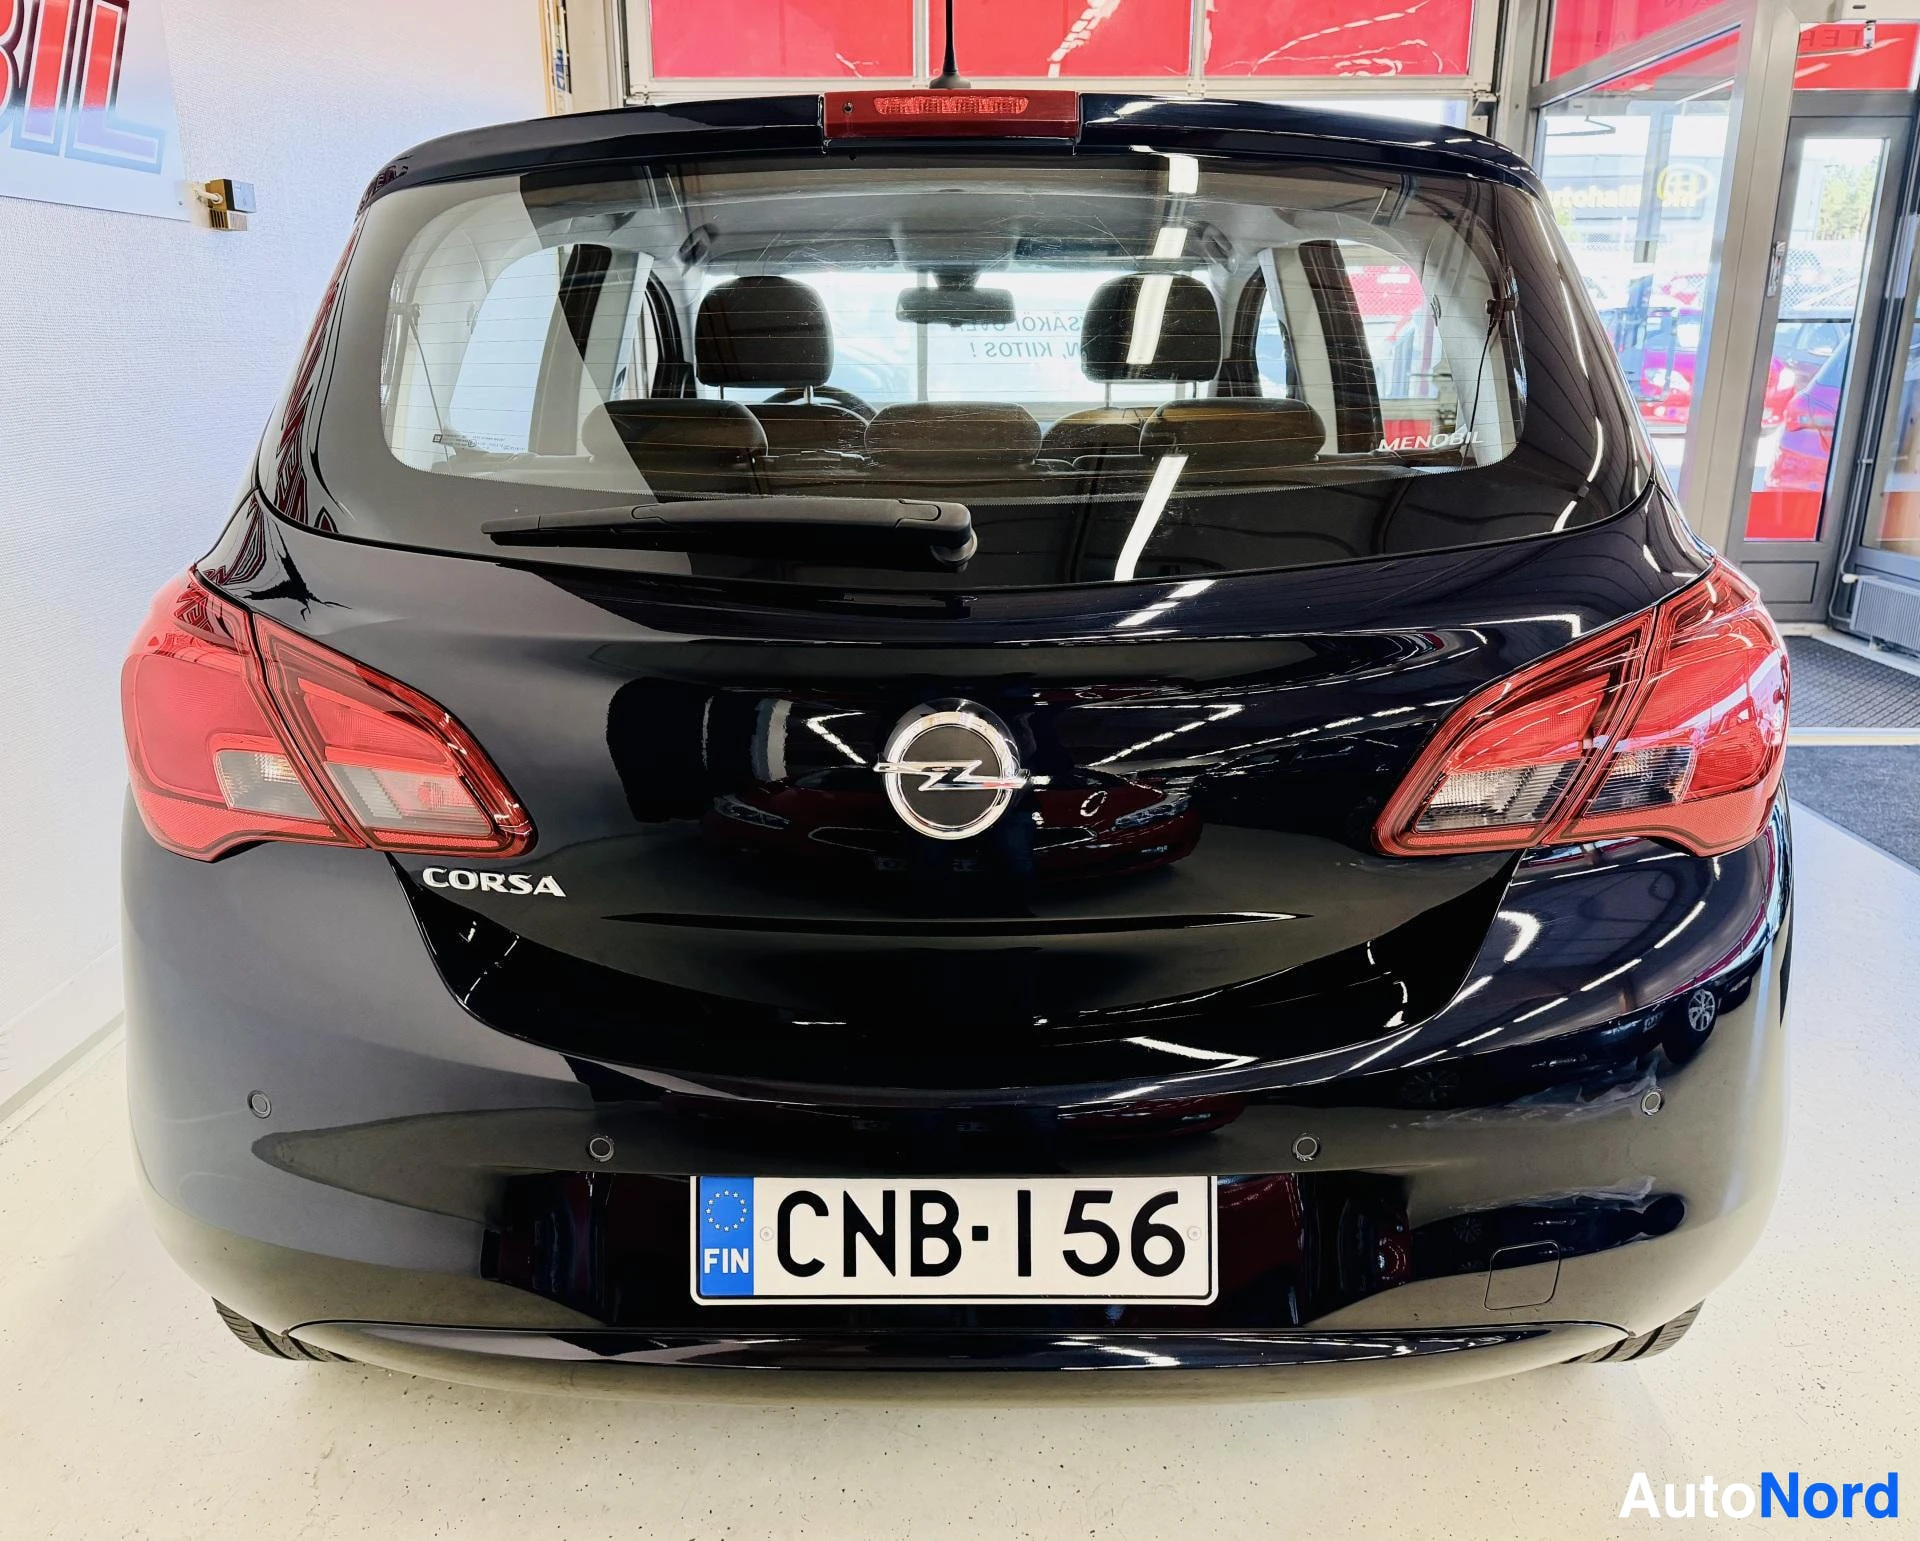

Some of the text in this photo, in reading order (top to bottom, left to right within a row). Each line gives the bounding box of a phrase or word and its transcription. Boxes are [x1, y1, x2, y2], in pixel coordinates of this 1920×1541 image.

[1378, 431, 1485, 451] MENOBIL
[422, 867, 567, 898] CORSA
[704, 1189, 1186, 1278] FIN CNB-156
